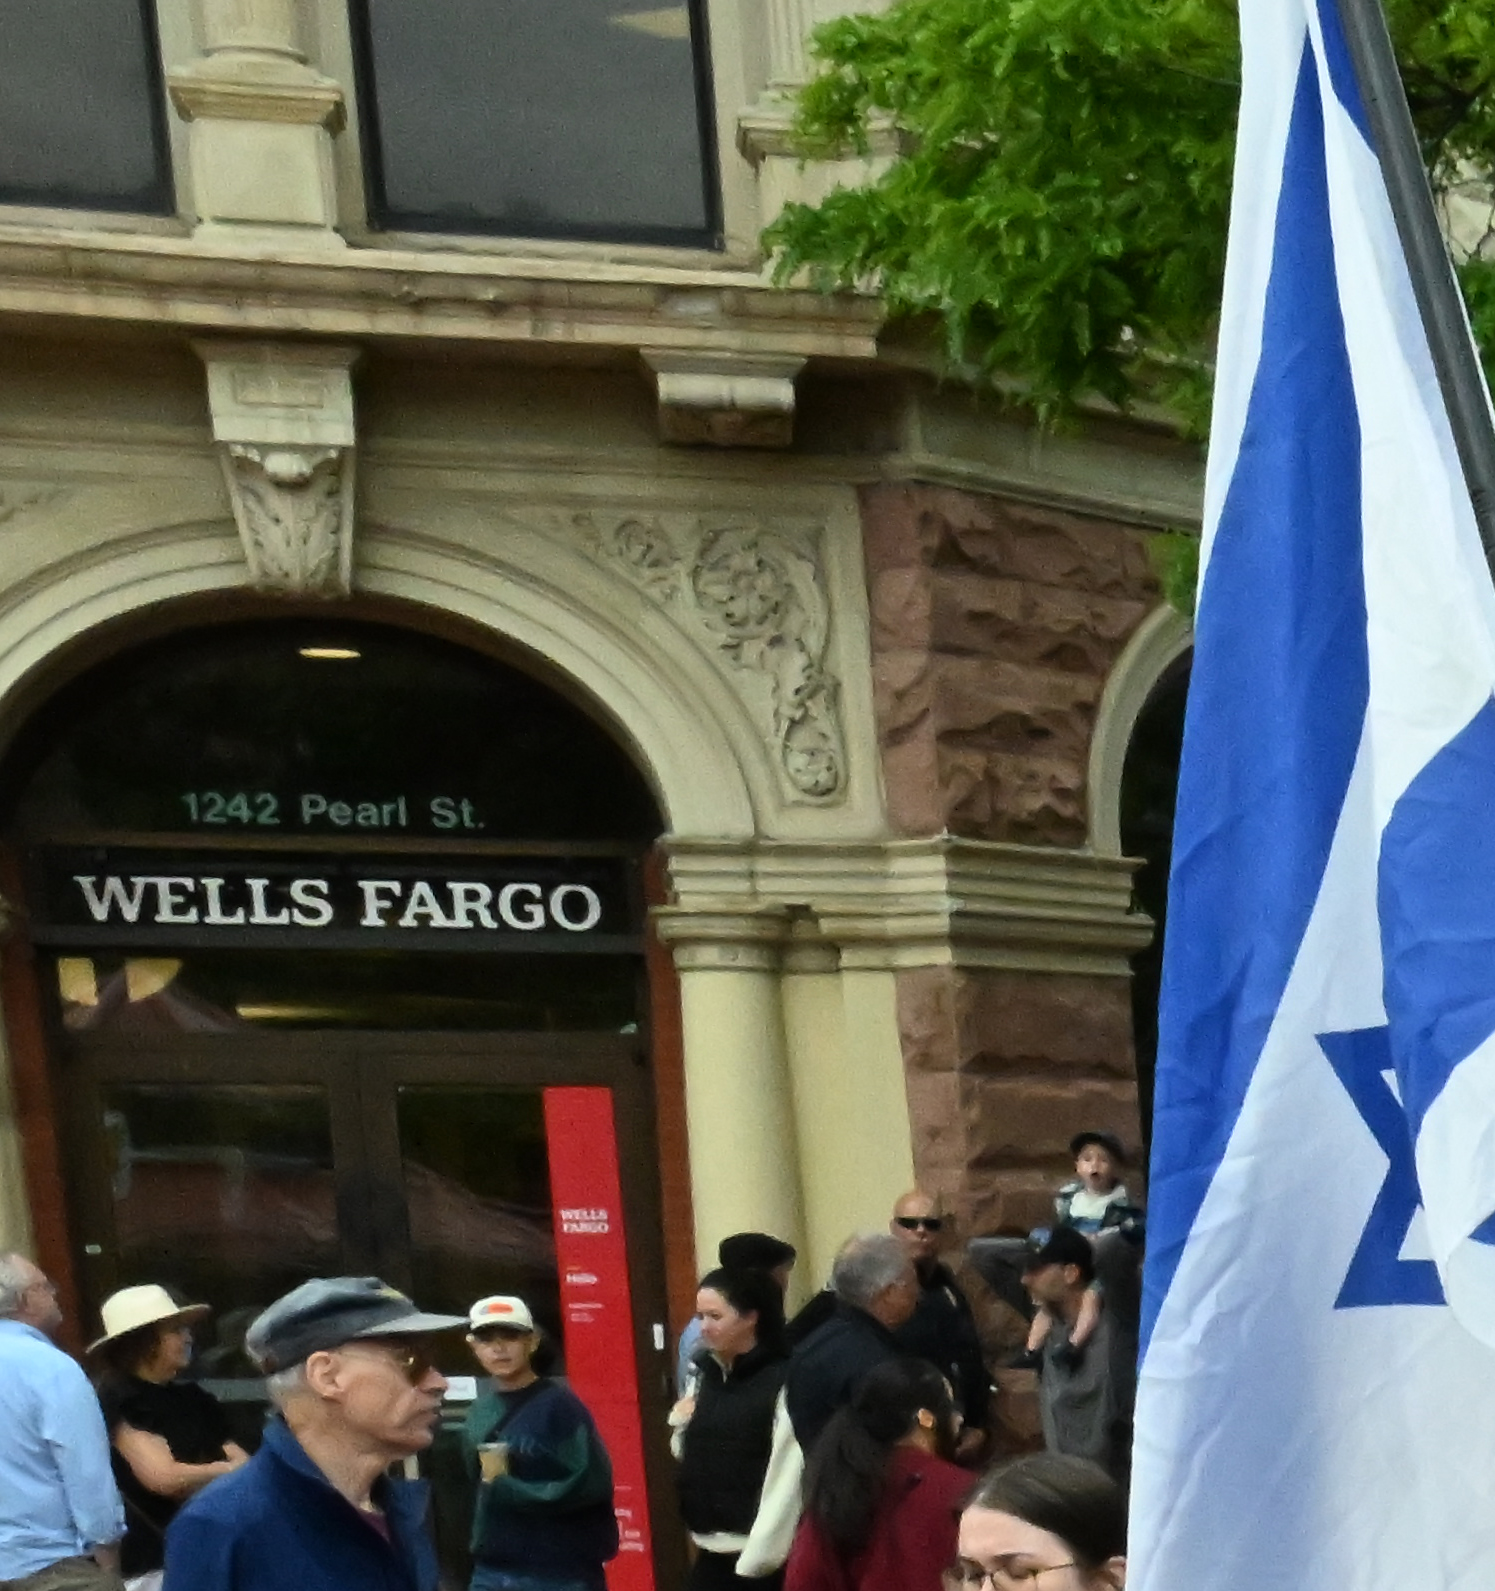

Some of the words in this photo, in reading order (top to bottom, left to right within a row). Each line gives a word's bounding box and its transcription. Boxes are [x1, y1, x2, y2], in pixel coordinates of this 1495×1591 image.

[181, 792, 281, 825] 1242
[300, 795, 407, 828] Pearl
[431, 797, 486, 829] St.
[73, 875, 335, 927] WELLS
[357, 879, 602, 933] FARGO
[560, 1209, 608, 1221] WELLS
[563, 1222, 609, 1233] FARGO
